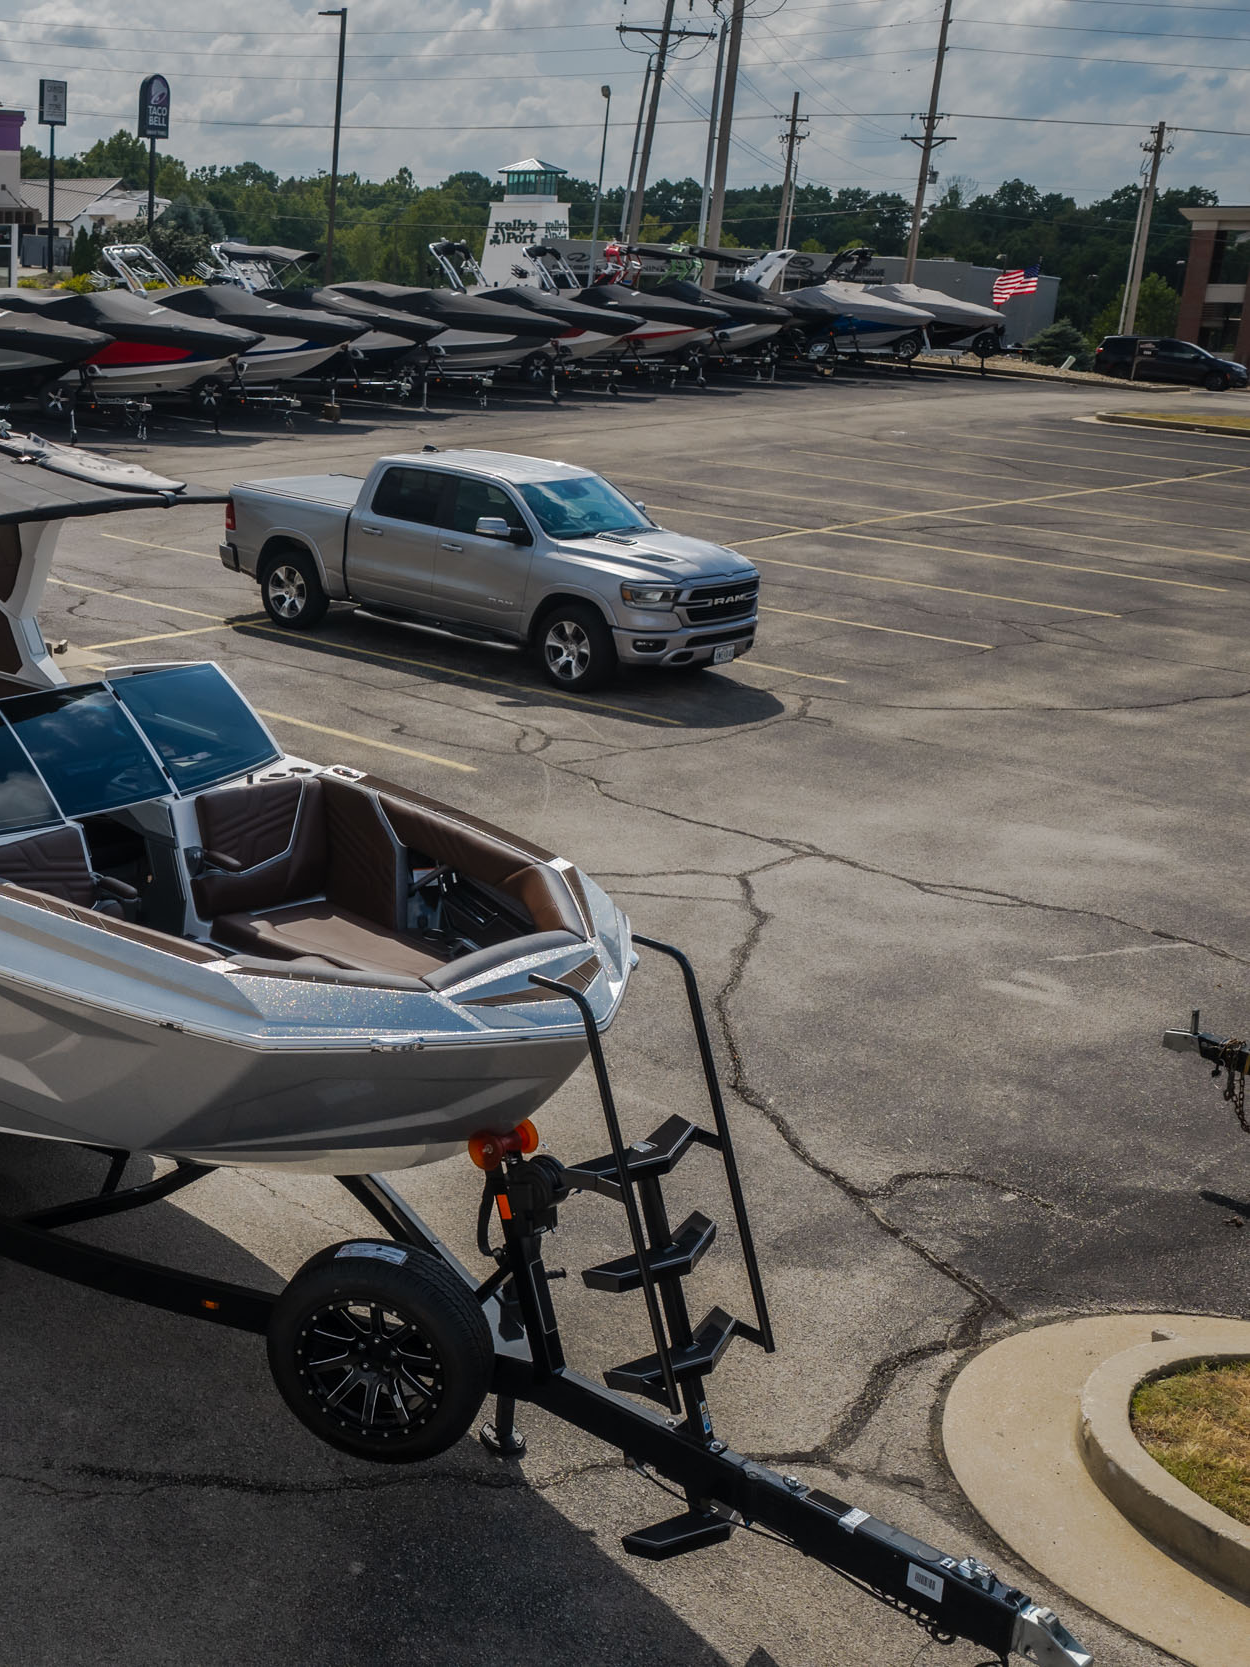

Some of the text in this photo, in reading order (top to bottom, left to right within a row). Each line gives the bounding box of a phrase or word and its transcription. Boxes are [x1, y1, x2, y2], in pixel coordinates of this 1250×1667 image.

[147, 105, 168, 116] TACO
[148, 115, 167, 127] BELL
[493, 219, 538, 239] Kelly's
[506, 232, 536, 244] Port
[713, 594, 746, 606] RAM
